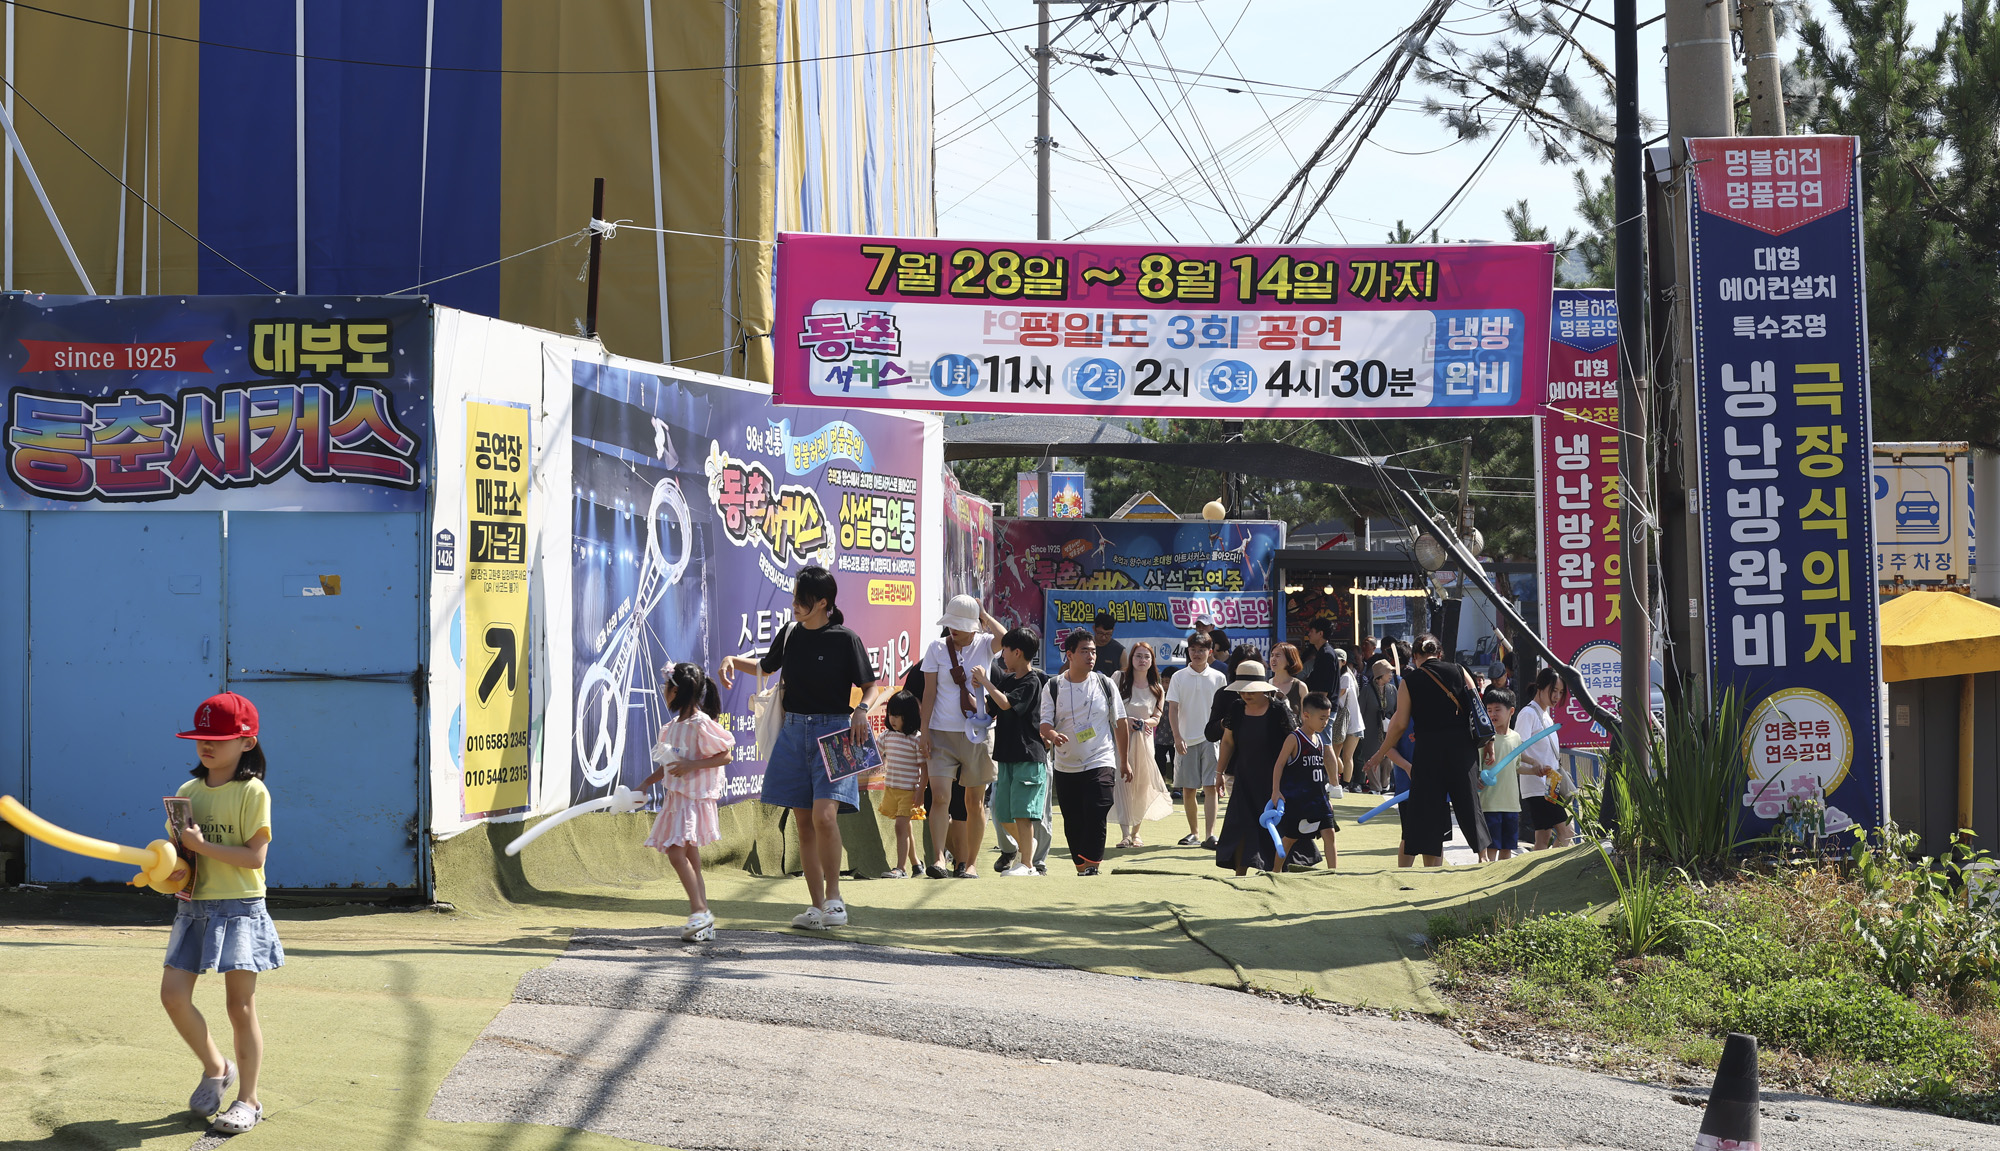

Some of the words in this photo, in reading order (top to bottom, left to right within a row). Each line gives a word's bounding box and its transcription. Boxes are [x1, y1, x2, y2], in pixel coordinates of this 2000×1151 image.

[1725, 148, 1821, 176] 명불허전
[1727, 180, 1823, 209] 명품공연
[861, 245, 940, 295] 7월
[951, 249, 1066, 299] 28일
[1137, 253, 1219, 303] 8월
[1231, 255, 1338, 304] 14일
[1350, 261, 1438, 301] 까지
[1754, 247, 1800, 271] 대형
[1719, 274, 1837, 301] 에어컨설치
[799, 311, 901, 361] 동춘
[1019, 312, 1149, 348] 평일도
[1167, 315, 1238, 349] 3회
[1257, 315, 1341, 350] 공연
[1448, 316, 1513, 350] 냉방
[1733, 313, 1827, 340] 특수조명
[54, 347, 115, 368] since
[125, 347, 177, 369] 1925
[253, 323, 389, 373] 대부도
[825, 359, 912, 392] 서커스
[984, 355, 1051, 394] 11시
[1134, 359, 1189, 397] 2시
[1446, 361, 1509, 395] 완비
[1574, 359, 1608, 377] 대형
[10, 385, 416, 497] 동춘서커스
[475, 431, 522, 473] 공연장
[746, 425, 764, 452] 98년
[765, 427, 782, 457] 전통
[793, 431, 828, 469] 명불허전!
[830, 426, 864, 463] 명품공연!
[475, 478, 522, 516] 매표소
[1793, 361, 1856, 664] 극장식의자
[839, 492, 916, 554] 상설공연중
[1721, 360, 1787, 667] 냉난방완비
[477, 525, 521, 561] 가는길
[1554, 434, 1596, 628] 냉난방완비
[438, 550, 453, 567] 1426
[1030, 545, 1046, 553] Since
[1047, 545, 1061, 553] 1925
[1112, 555, 1128, 566] 추억과
[1152, 555, 1172, 566] 초대형
[1054, 600, 1095, 622] 7월28일
[1108, 600, 1147, 622] 8월14일
[1148, 602, 1169, 621] 까지
[467, 735, 484, 752] 010
[486, 733, 508, 750] 6583
[510, 731, 526, 748] 2345
[1765, 720, 1831, 741] 연중무휴
[1766, 742, 1831, 764] 연속공연
[465, 770, 484, 787] 010
[487, 767, 508, 785] 5442
[510, 765, 528, 783] 2315
[1312, 769, 1323, 782] 01
